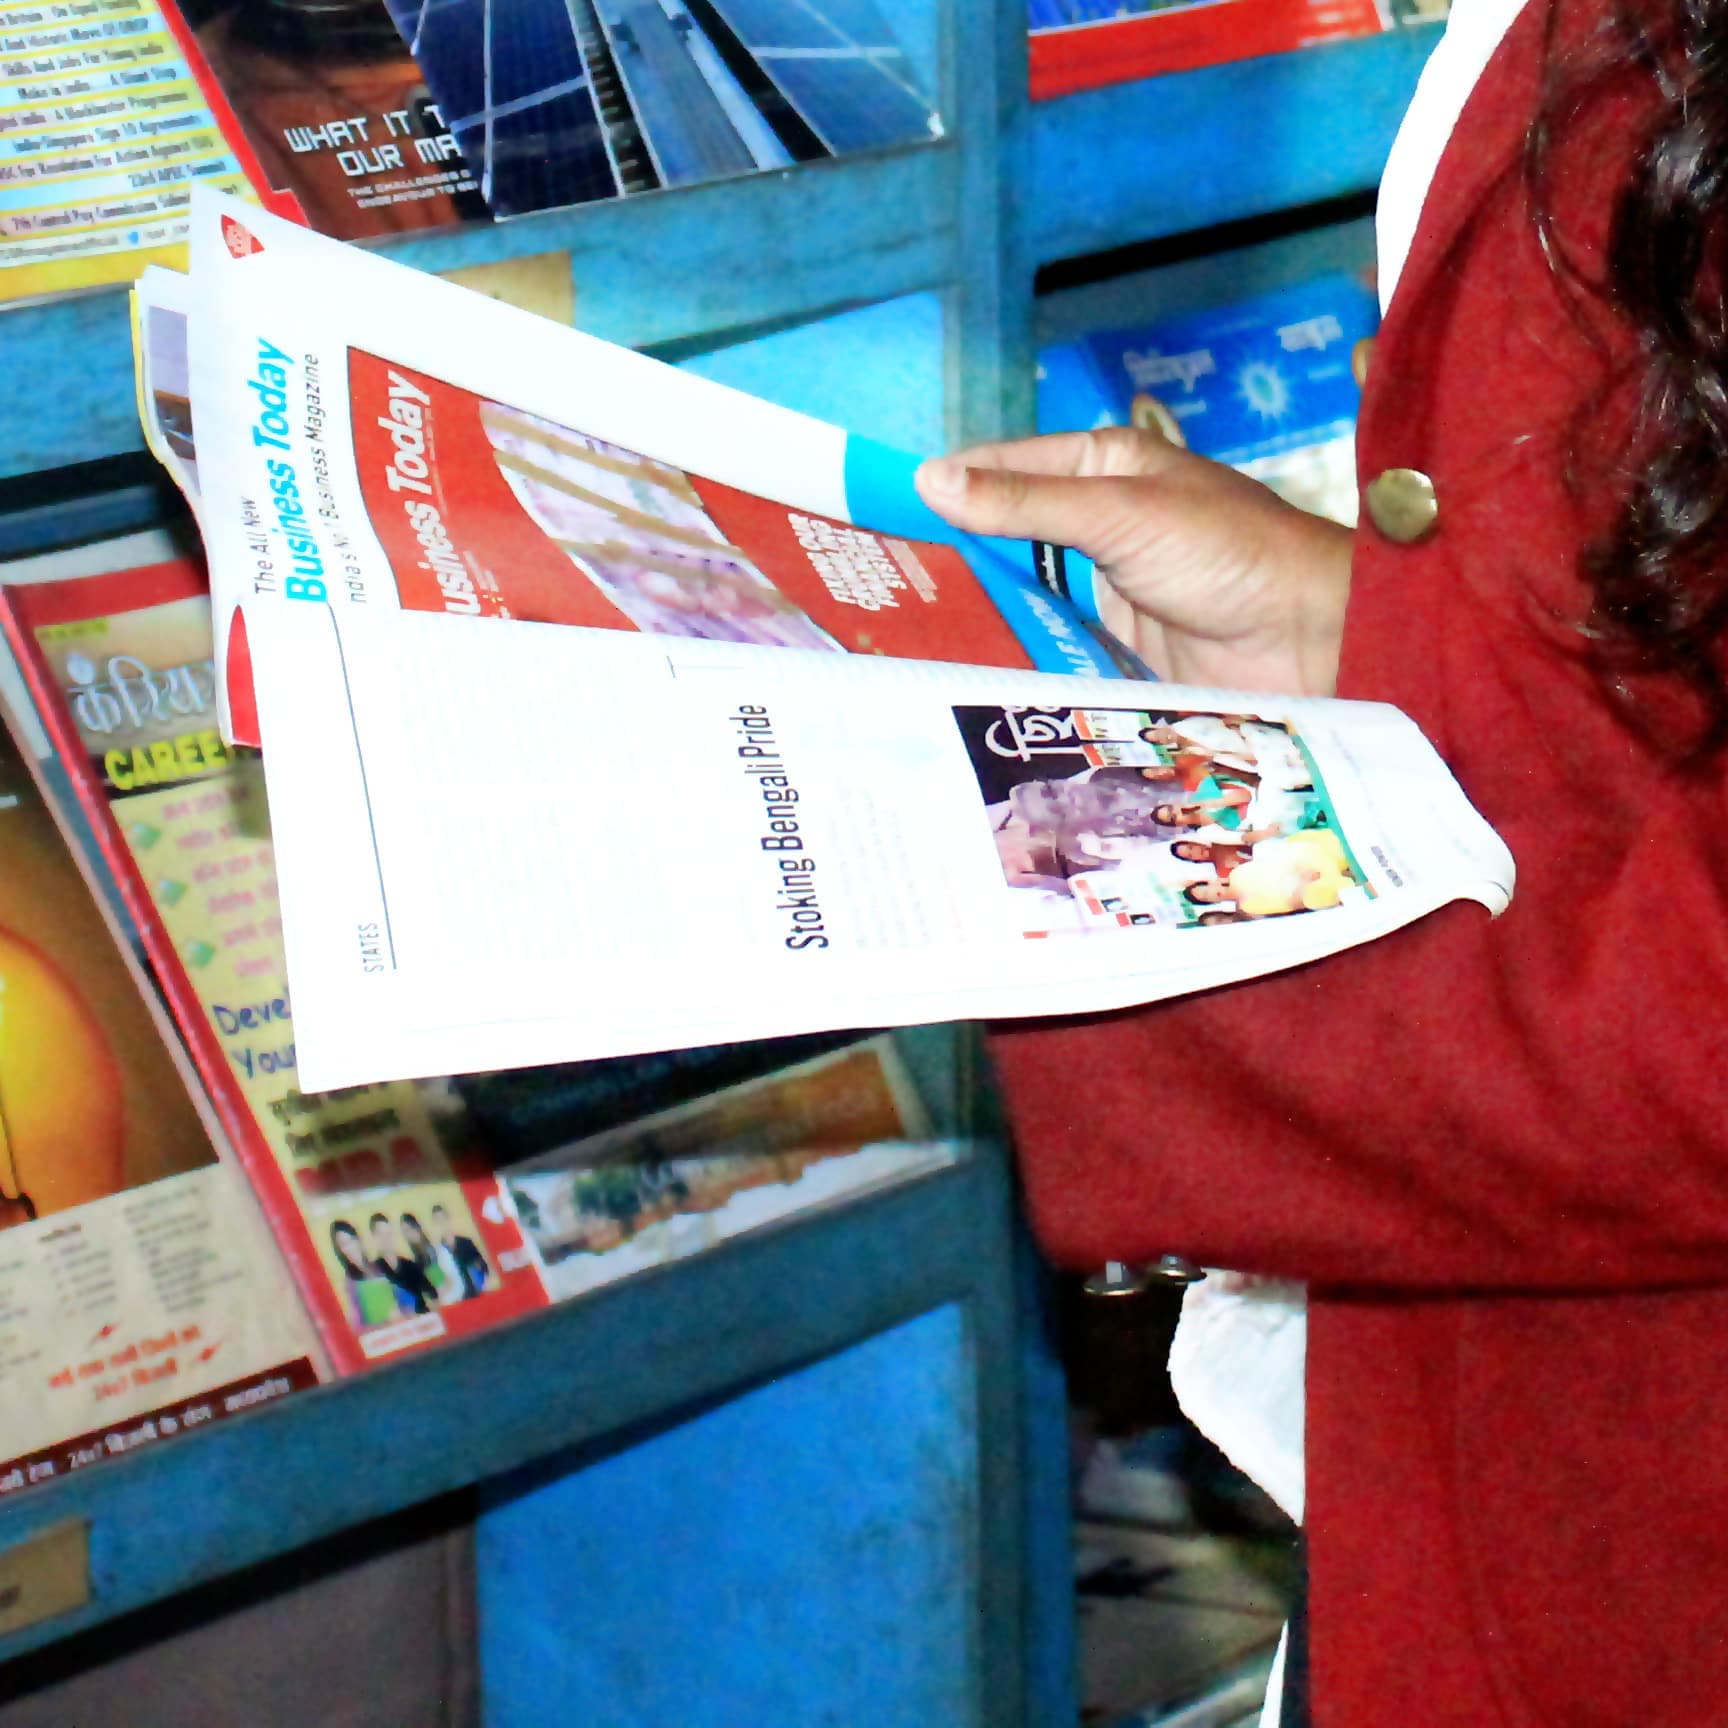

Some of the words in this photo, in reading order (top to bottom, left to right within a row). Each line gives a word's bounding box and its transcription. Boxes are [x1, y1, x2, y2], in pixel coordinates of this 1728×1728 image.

[283, 116, 371, 154] WHAT
[382, 109, 411, 138] IT
[336, 143, 405, 177] OUR
[414, 133, 464, 164] MA
[247, 335, 296, 452] Today
[301, 352, 330, 448] Magazine
[376, 370, 437, 496] Today
[241, 496, 268, 528] New
[266, 456, 330, 605] Business
[254, 557, 278, 595] The
[728, 702, 782, 760] Pride
[743, 763, 805, 853] Bengali
[776, 857, 830, 951] Stoking
[357, 921, 386, 974] STATES
[212, 991, 291, 1037] Deve
